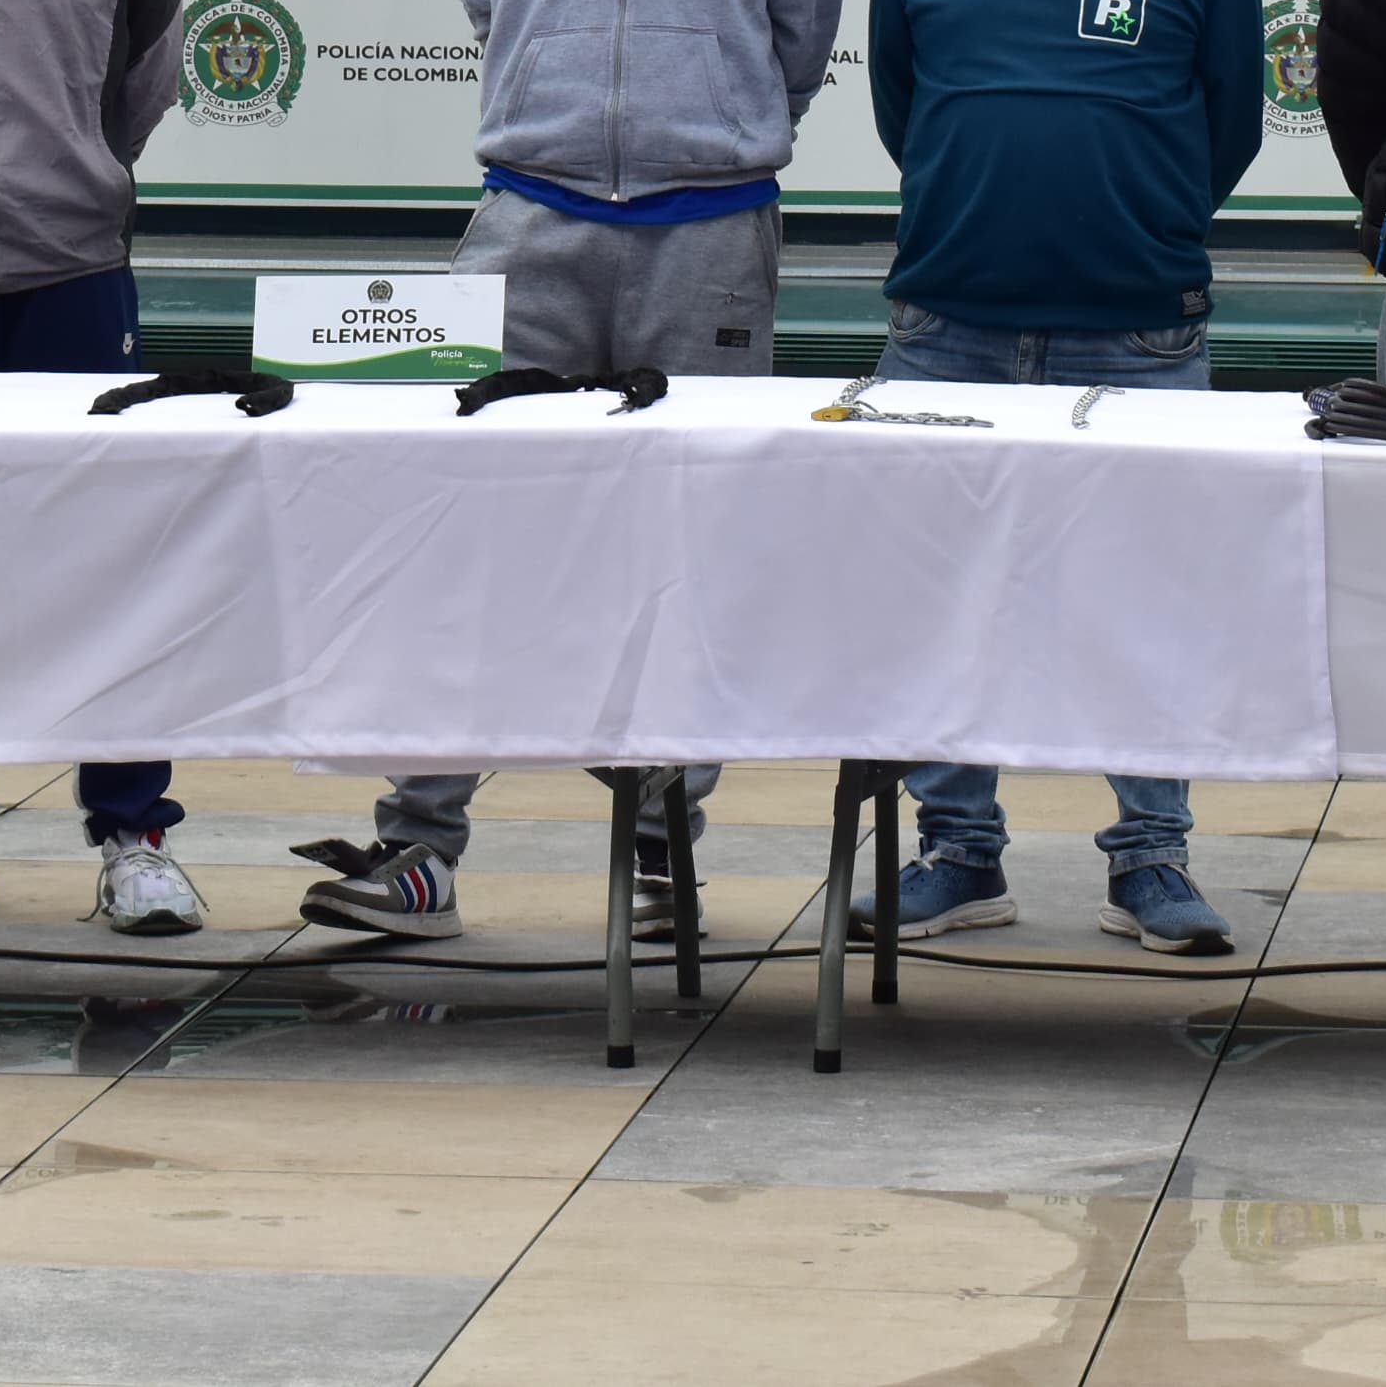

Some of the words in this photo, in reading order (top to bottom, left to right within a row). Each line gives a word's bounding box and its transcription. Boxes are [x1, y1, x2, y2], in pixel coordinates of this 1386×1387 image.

[318, 41, 394, 59] POLICÍA
[401, 46, 483, 60] NACION
[344, 67, 367, 81] DE
[374, 68, 478, 82] COLOMBIA
[341, 309, 417, 324] OTROS
[312, 327, 446, 344] ELEMENTOS
